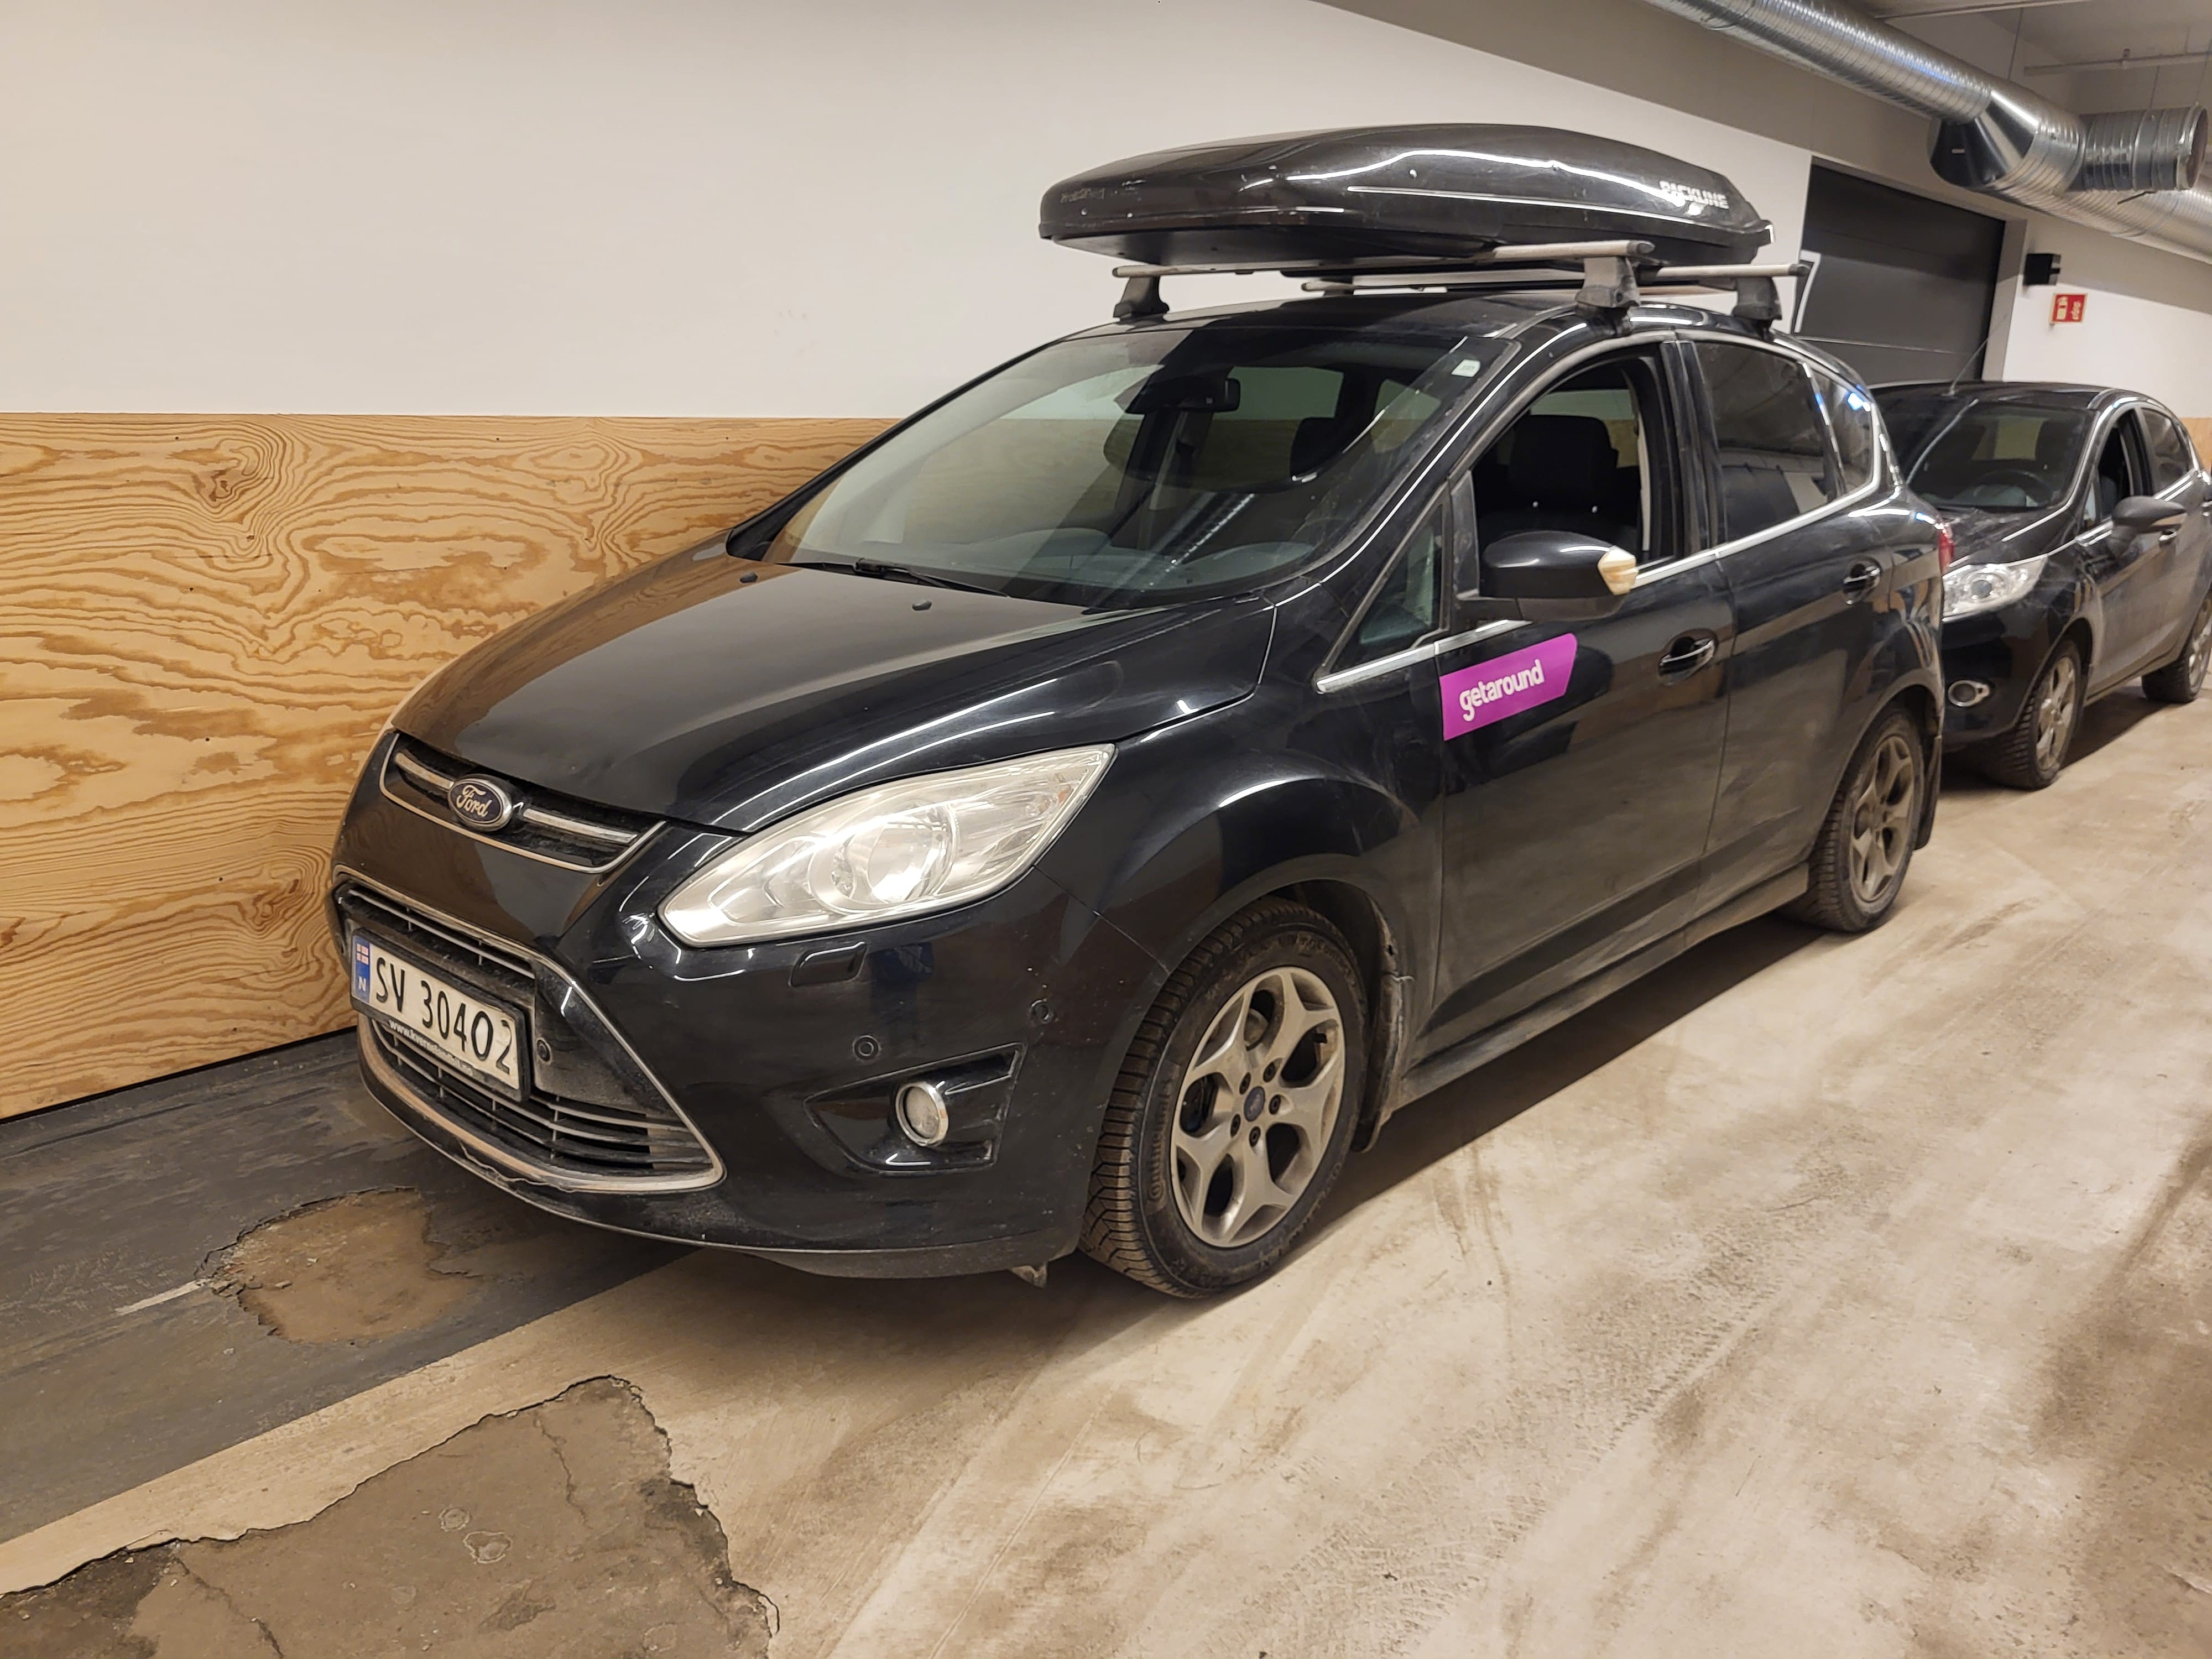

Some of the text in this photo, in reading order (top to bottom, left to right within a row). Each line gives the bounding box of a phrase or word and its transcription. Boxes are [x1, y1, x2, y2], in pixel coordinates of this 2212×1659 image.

[1459, 659, 1545, 722] getaround
[456, 785, 492, 817] Ford
[358, 977, 367, 992] N
[376, 957, 512, 1075] SV 30402
